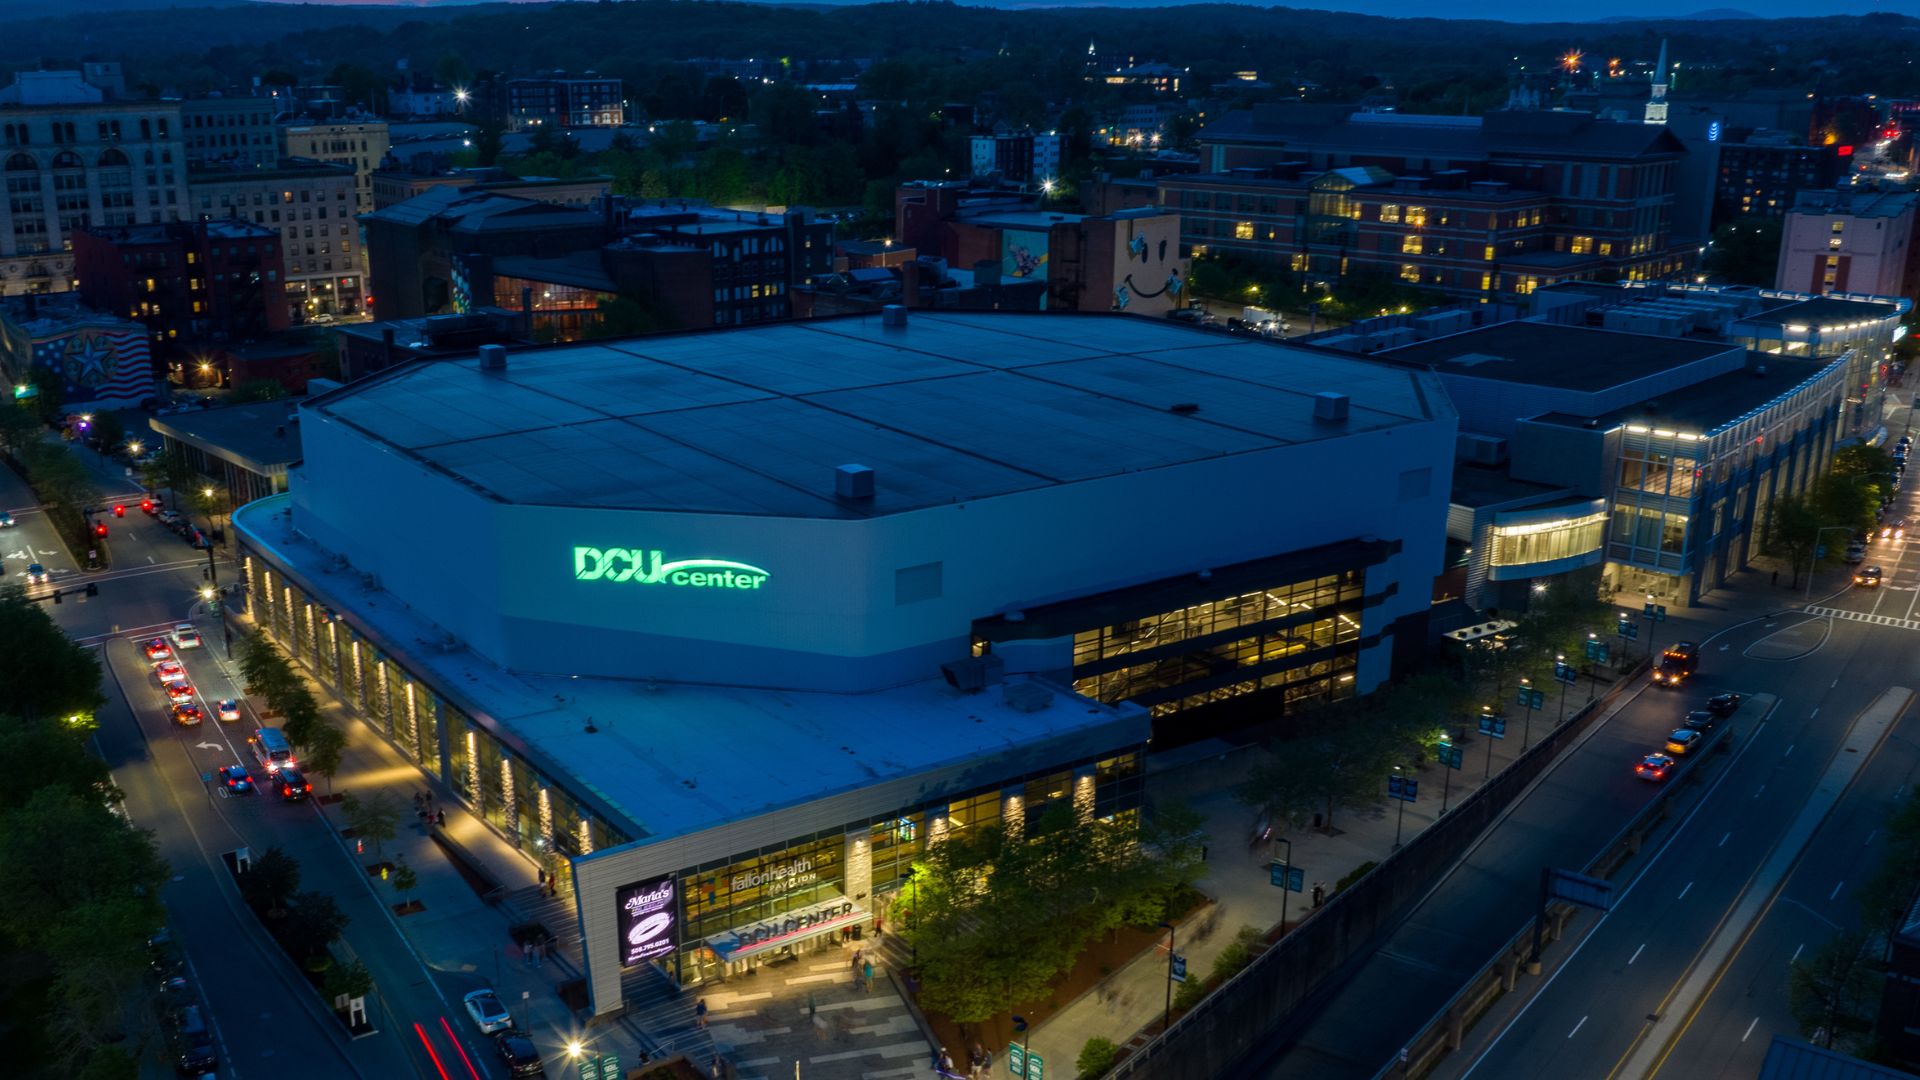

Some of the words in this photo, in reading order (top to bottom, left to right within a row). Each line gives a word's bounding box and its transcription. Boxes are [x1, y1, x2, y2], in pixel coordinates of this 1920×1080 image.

[575, 546, 663, 584] DCU
[671, 571, 767, 589] center
[731, 857, 812, 892] fallonhealth
[783, 902, 853, 935] CENTER
